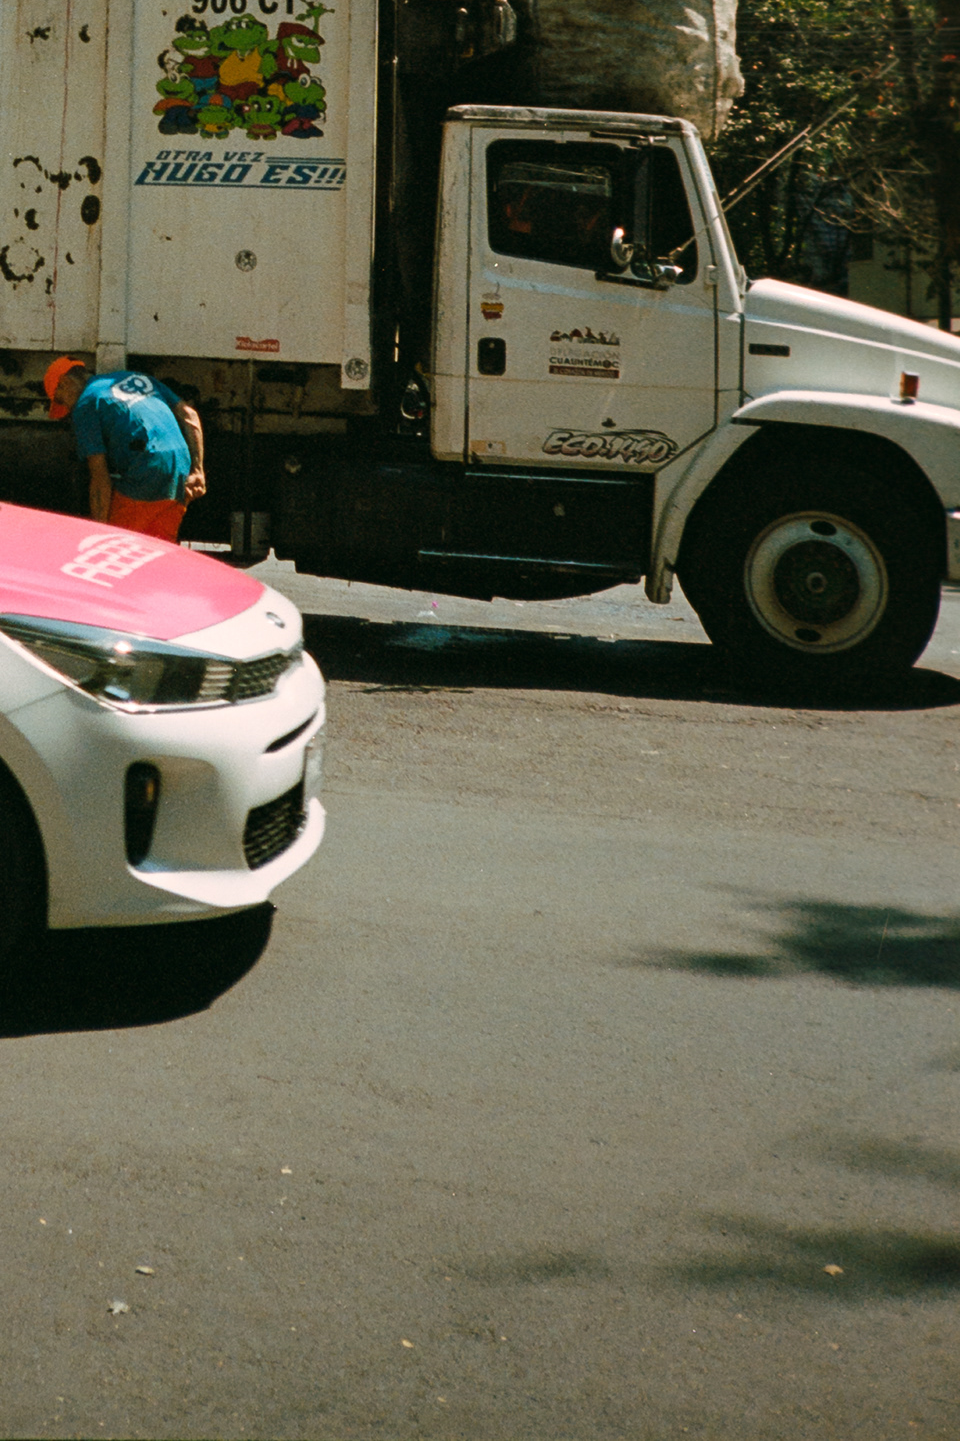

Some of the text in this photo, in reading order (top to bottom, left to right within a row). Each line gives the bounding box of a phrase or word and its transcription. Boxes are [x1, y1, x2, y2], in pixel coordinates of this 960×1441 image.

[155, 149, 265, 163] OTRA VEZ
[134, 161, 253, 185] HUGO
